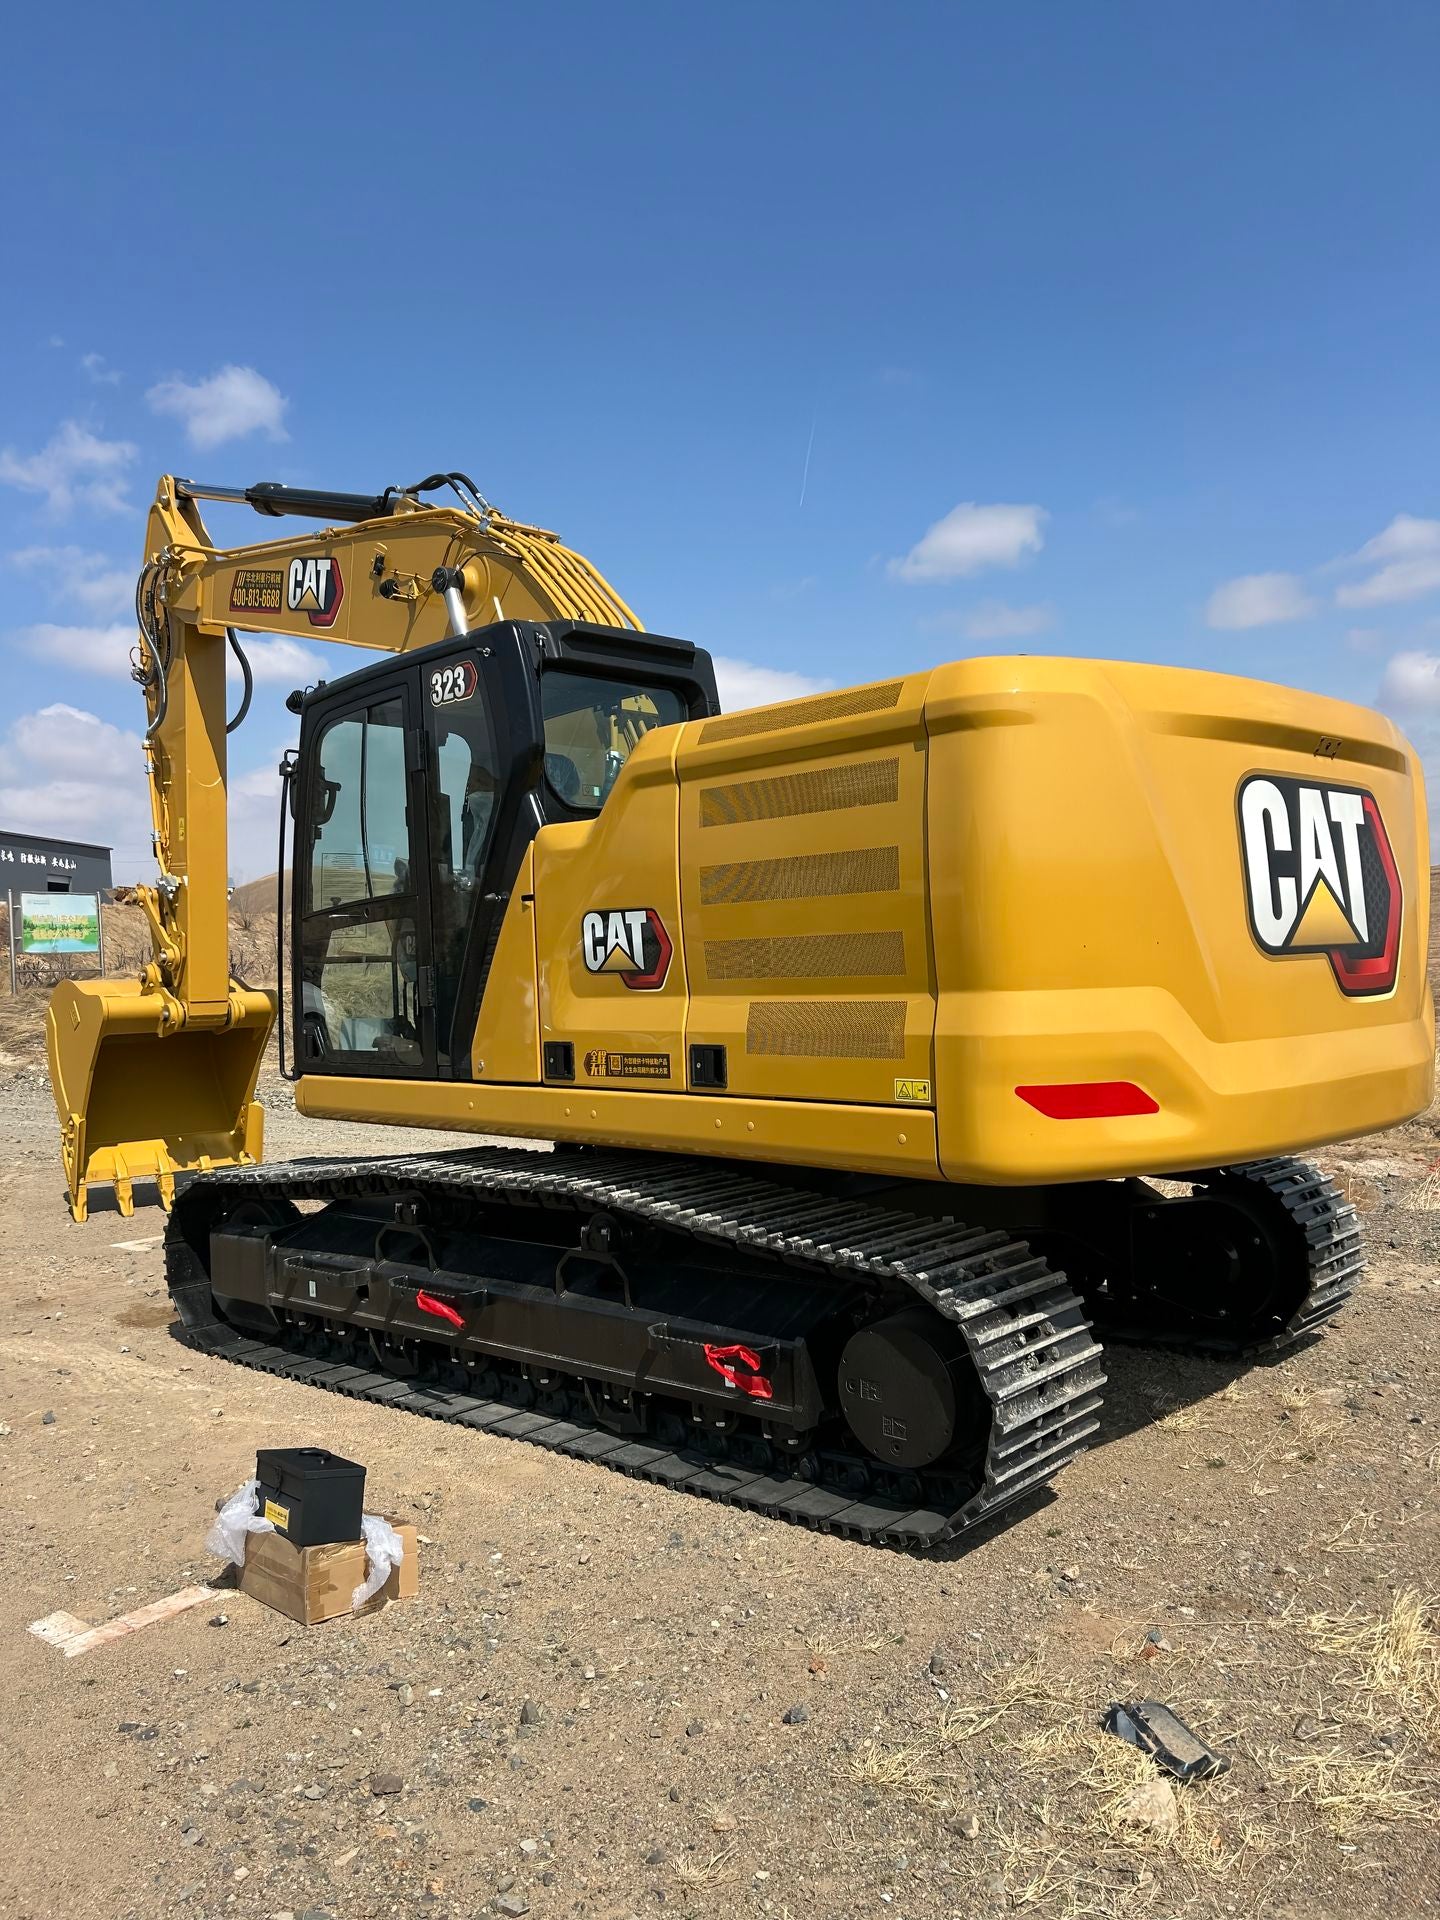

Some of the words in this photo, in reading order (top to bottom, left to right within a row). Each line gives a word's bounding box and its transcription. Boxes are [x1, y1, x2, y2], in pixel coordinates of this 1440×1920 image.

[232, 588, 280, 608] 400-813-6688
[289, 559, 331, 610] CAT
[432, 666, 466, 704] 323
[1241, 779, 1369, 947] CAT
[583, 911, 647, 971] CAT
[590, 1050, 607, 1064] 全程
